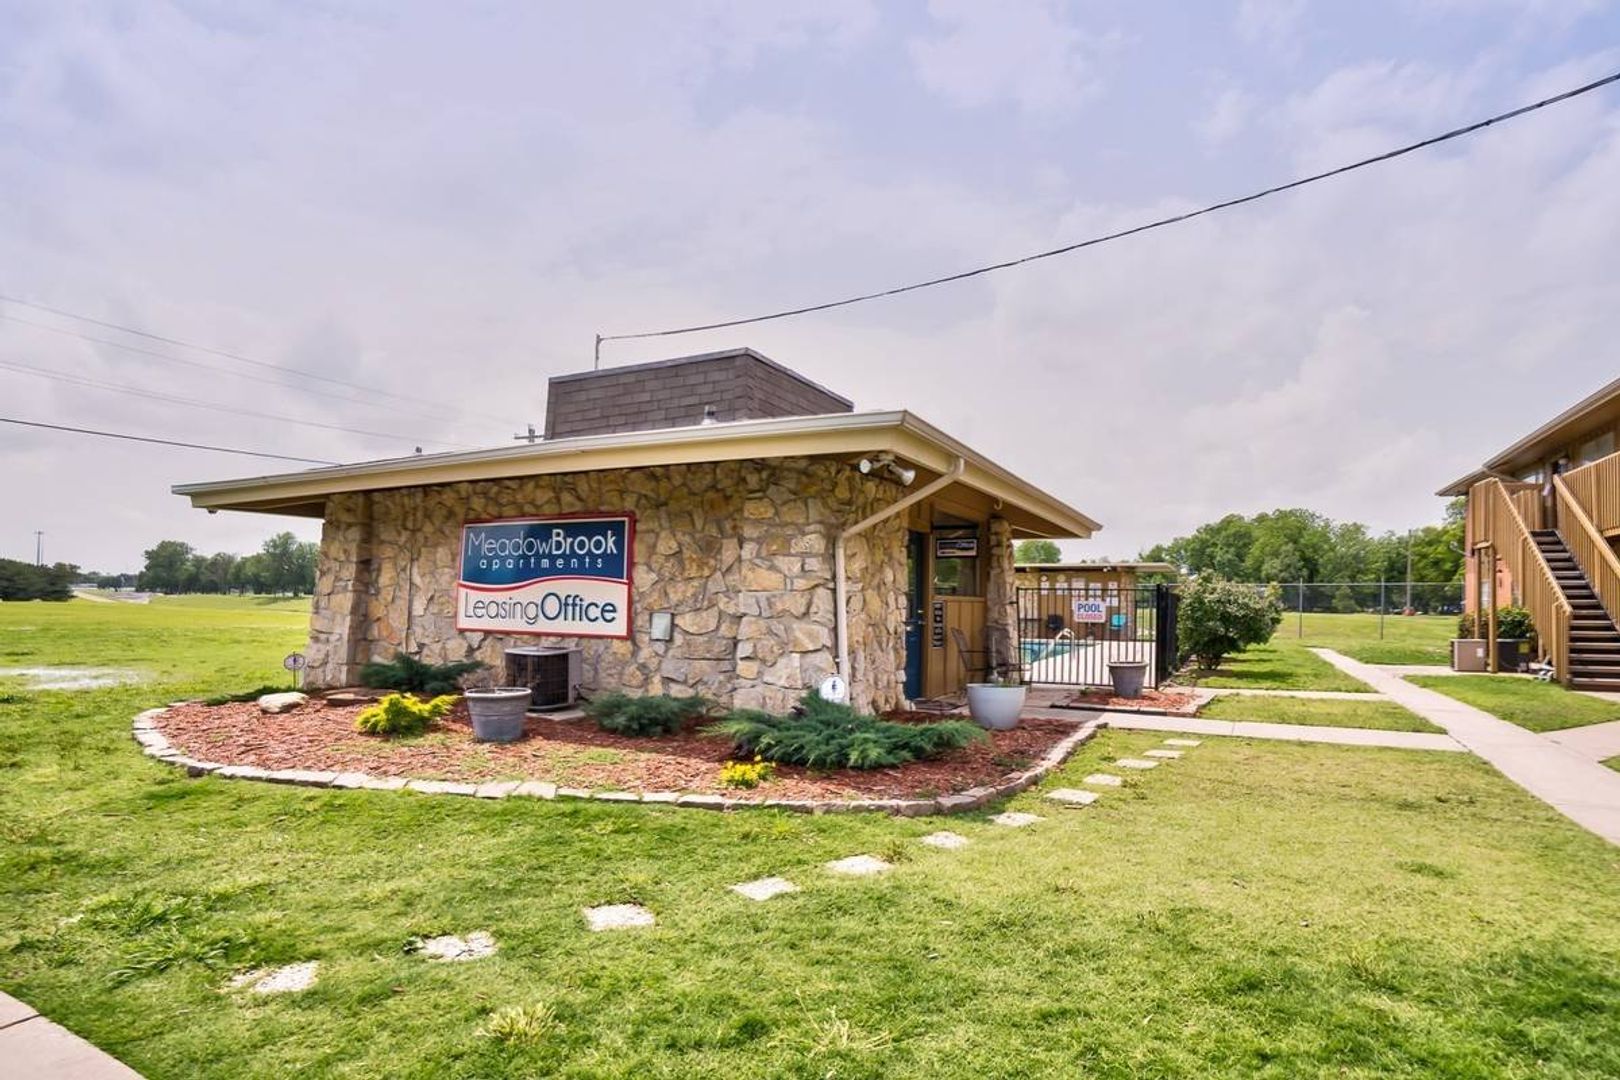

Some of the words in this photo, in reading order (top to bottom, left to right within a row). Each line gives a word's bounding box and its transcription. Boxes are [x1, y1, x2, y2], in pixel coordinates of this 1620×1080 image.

[468, 529, 617, 556] MeadowBrook
[479, 556, 602, 571] apartments
[1077, 603, 1103, 613] POOL
